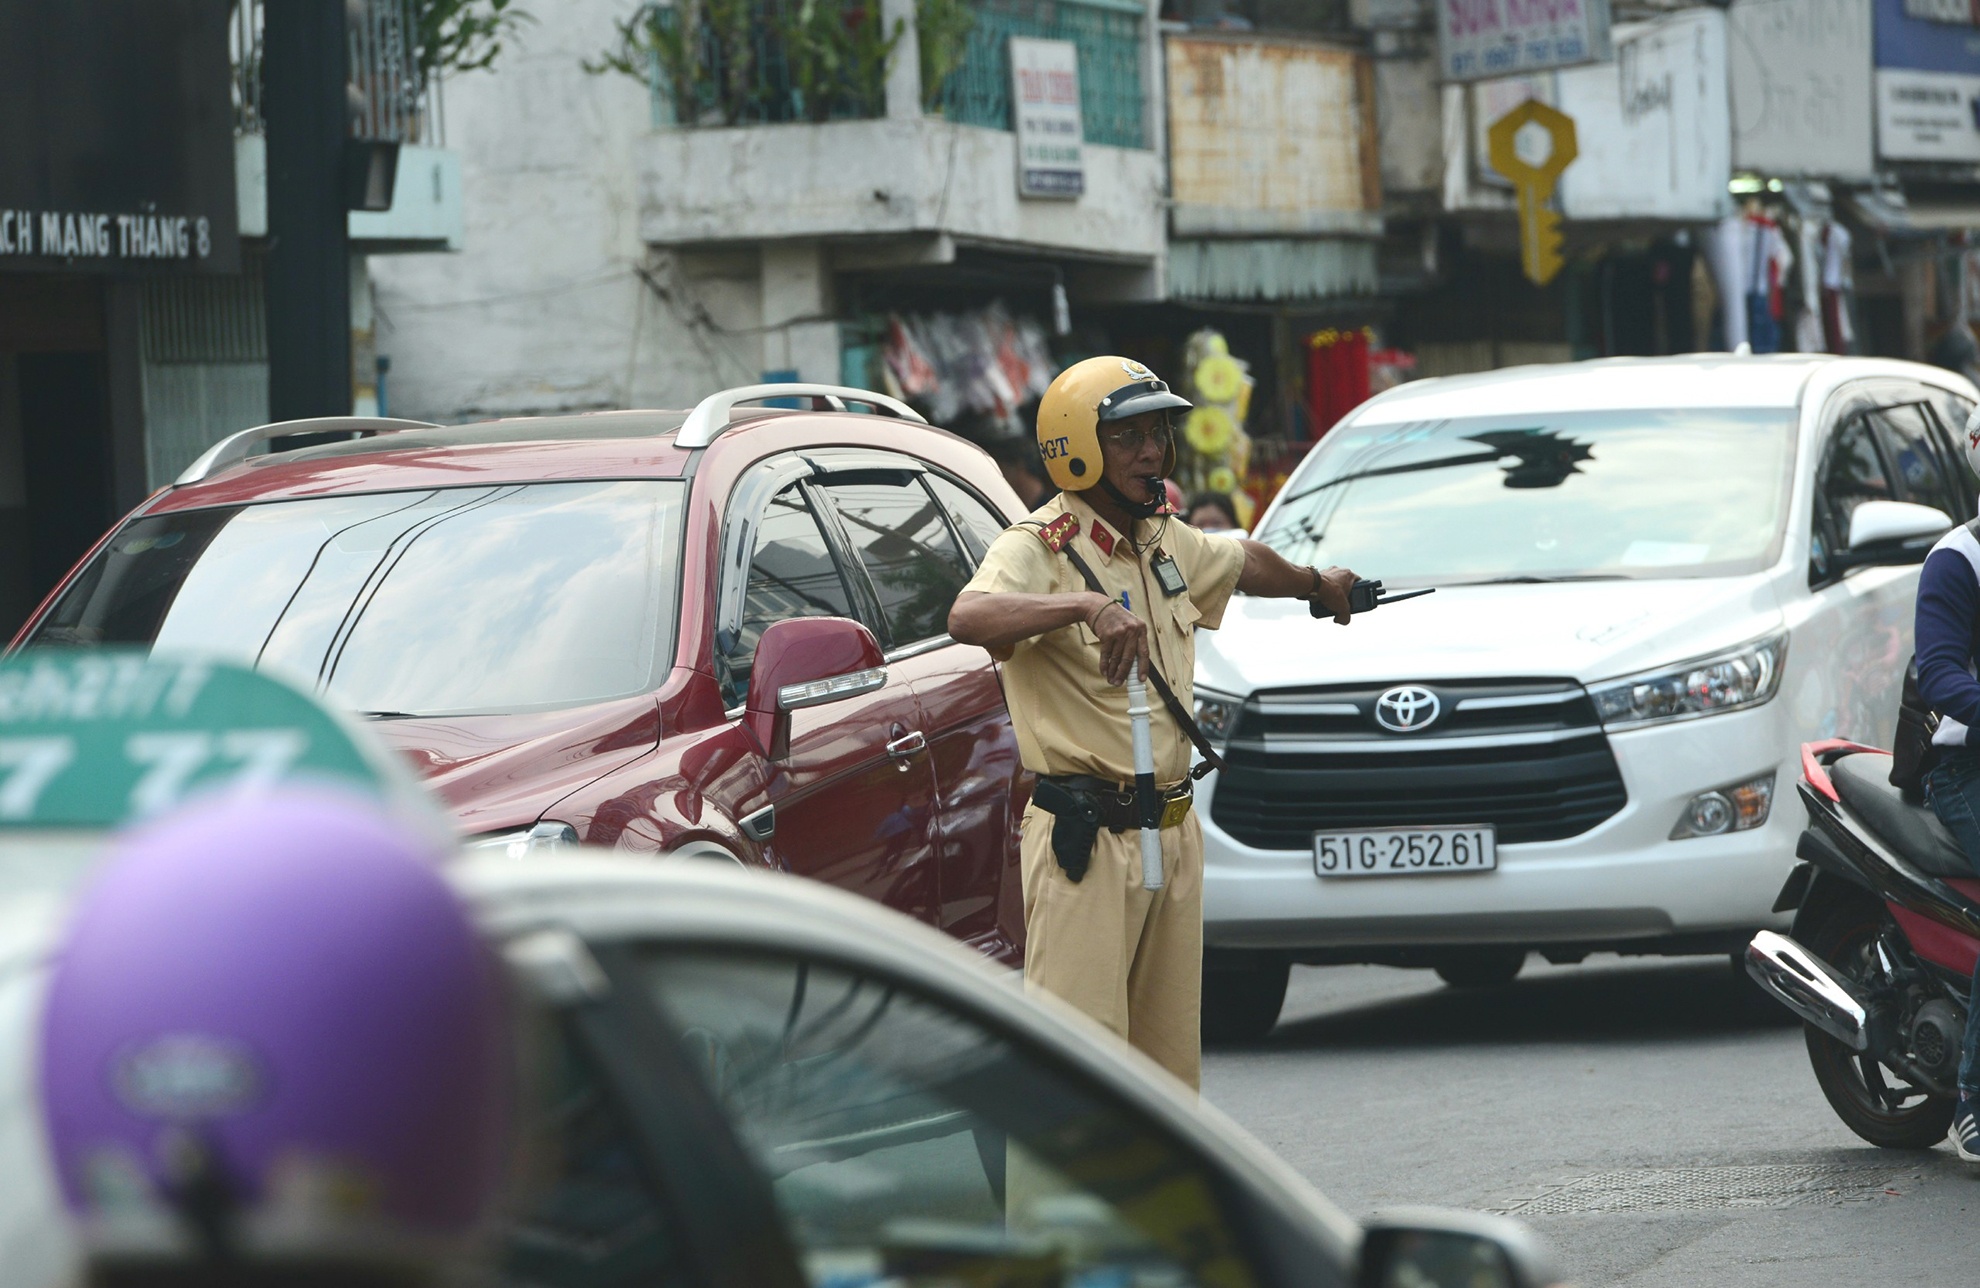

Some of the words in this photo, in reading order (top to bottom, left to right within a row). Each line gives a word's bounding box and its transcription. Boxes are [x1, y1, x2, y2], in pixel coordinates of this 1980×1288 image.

[0, 210, 32, 255] CH
[41, 211, 110, 266] MẠNG
[196, 215, 210, 257] 8
[1320, 833, 1484, 870] 51G-252.61
